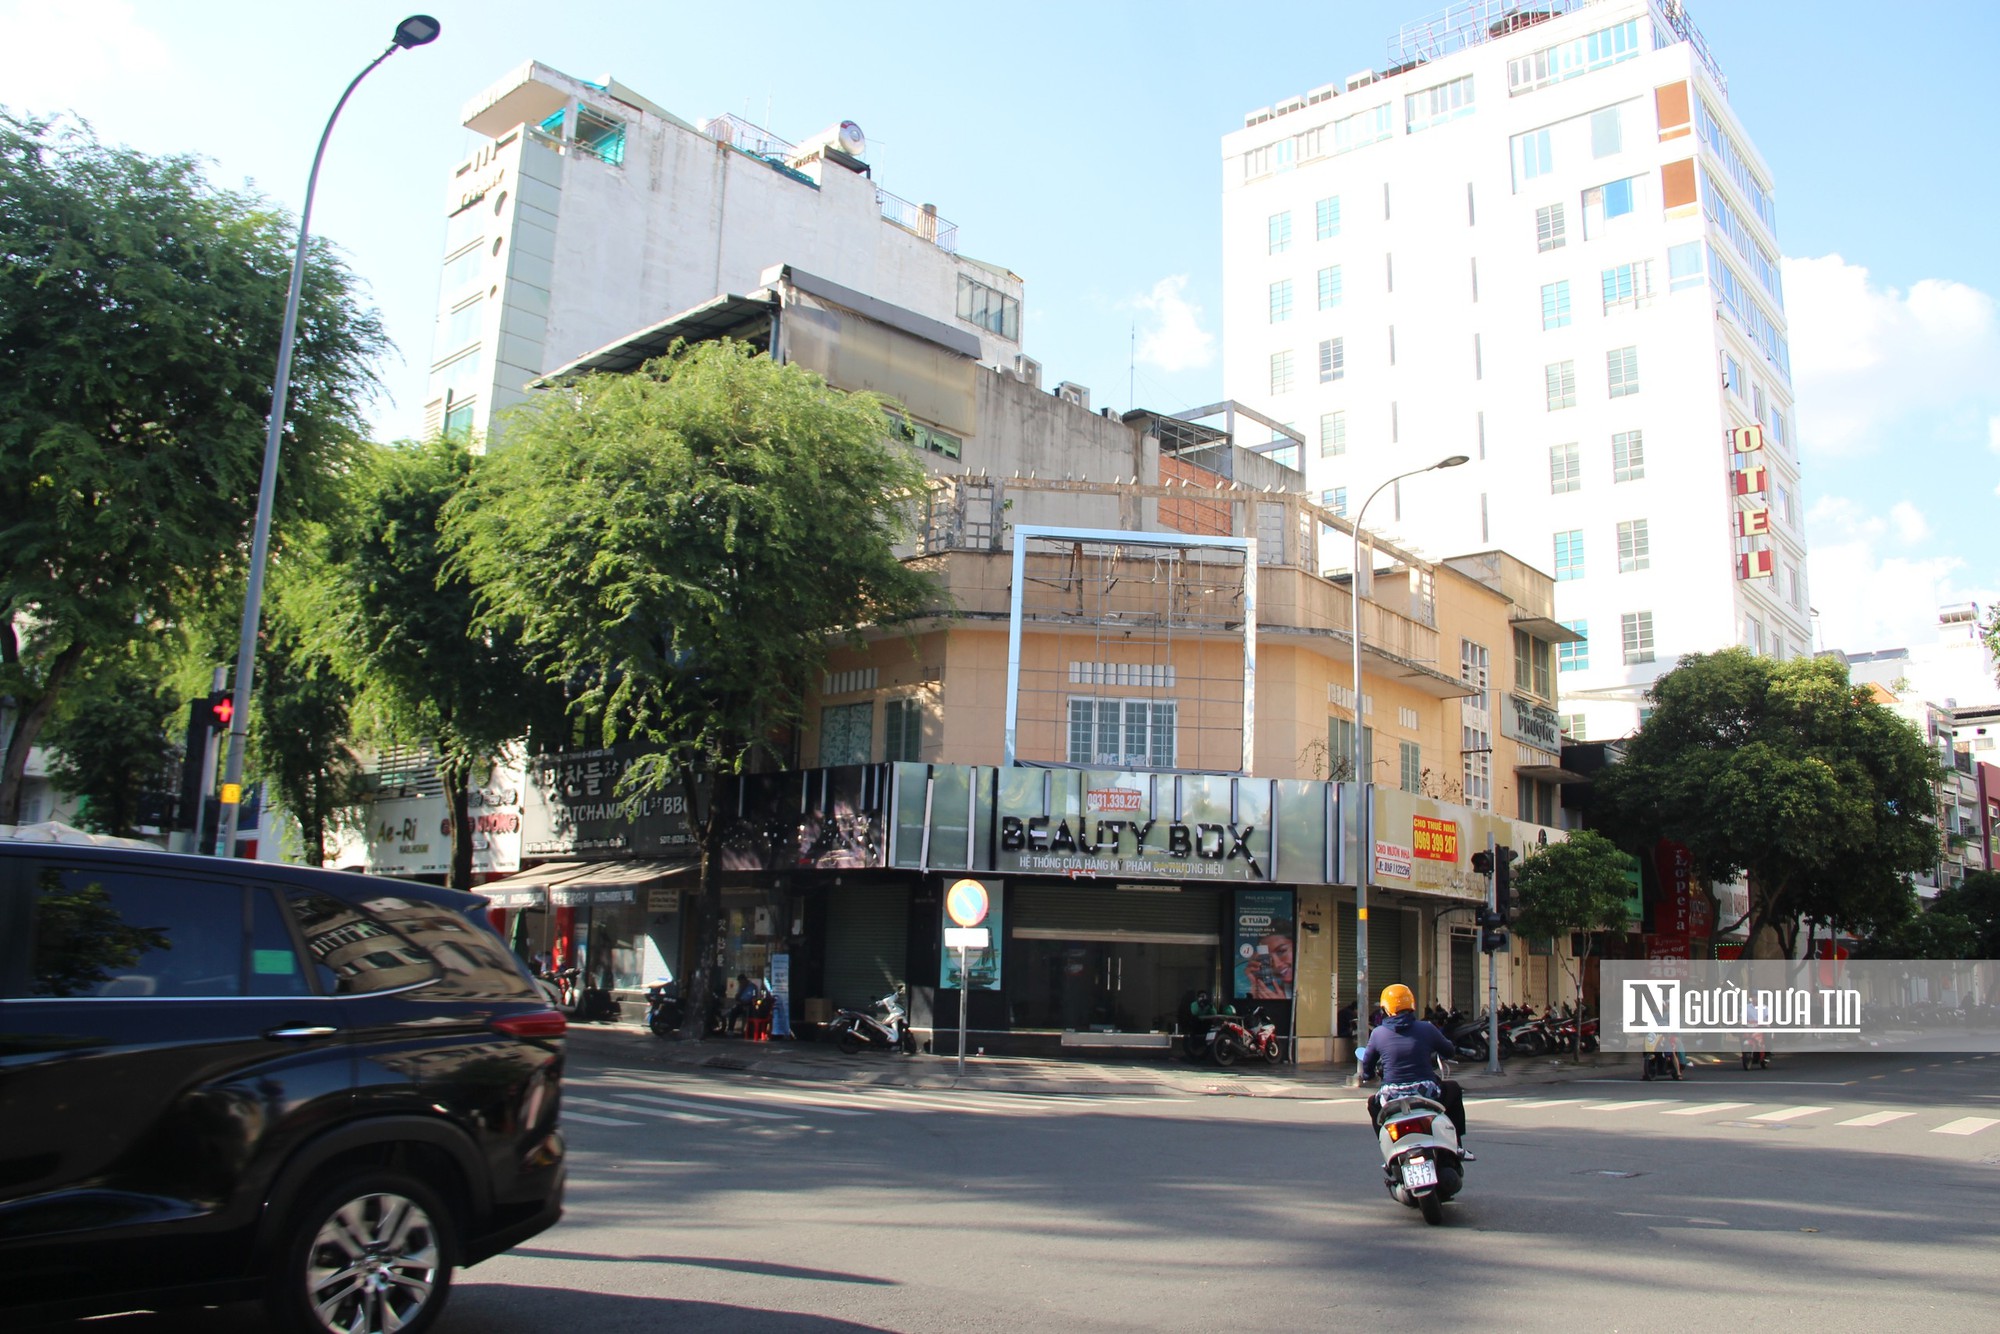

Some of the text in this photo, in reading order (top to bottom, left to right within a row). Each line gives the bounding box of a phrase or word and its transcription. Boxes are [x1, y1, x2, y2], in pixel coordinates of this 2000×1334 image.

[1734, 425, 1773, 579] OTEL
[1413, 818, 1426, 828] CHO
[1002, 816, 1264, 878] BEAUTY BOX
[1020, 855, 1030, 869] HỆ
[1033, 854, 1060, 869] THỐNG
[1063, 856, 1081, 870] CỬA
[1084, 856, 1109, 871] HÀNG
[1205, 861, 1224, 877] HIỆU
[1408, 1173, 1432, 1187] 9217
